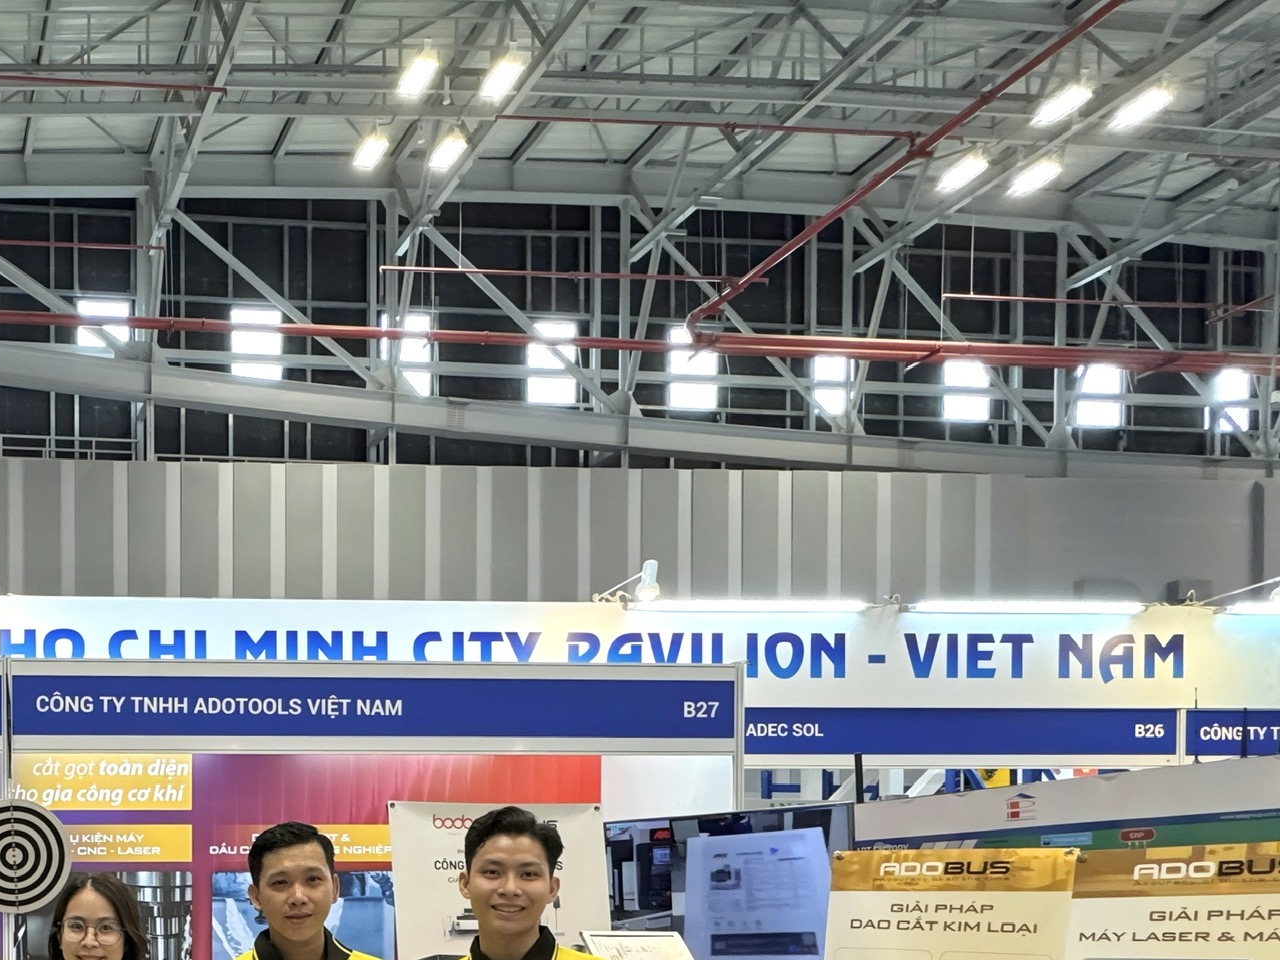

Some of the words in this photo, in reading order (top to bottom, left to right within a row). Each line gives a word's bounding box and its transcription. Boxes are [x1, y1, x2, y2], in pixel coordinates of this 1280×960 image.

[108, 629, 207, 660] CHI
[234, 629, 389, 661] MINH
[412, 631, 542, 663] CITY
[903, 633, 1035, 679] VIET
[1058, 633, 1185, 685] NAM
[35, 691, 94, 713] CÔNG
[99, 696, 127, 713] TY
[130, 696, 189, 714] TNHH
[193, 696, 302, 716] ADOTOOLS
[305, 694, 352, 719] VIỆT
[356, 699, 403, 716] NAM
[683, 701, 719, 718] B27
[745, 723, 789, 737] ADEC
[792, 723, 825, 738] SOL
[1134, 723, 1165, 738] B26
[1199, 722, 1244, 740] CÔNG
[1246, 726, 1268, 740] TY
[32, 758, 61, 776] cắt
[64, 761, 96, 783] gọt
[98, 758, 144, 776] toàn
[147, 758, 189, 779] diện
[41, 785, 71, 806] gia
[76, 784, 123, 806] công
[126, 786, 151, 803] cơ
[153, 784, 185, 803] khí
[81, 833, 113, 845] KIỆN
[115, 832, 145, 843] MÁY
[340, 834, 351, 842] &
[77, 846, 107, 855] CNC
[117, 846, 161, 855] LASER
[342, 843, 392, 857] NGHIỆP
[434, 858, 465, 870] CÔNG
[879, 860, 1011, 876] ADOBUS
[1133, 858, 1280, 880] ADOBU
[890, 901, 929, 914] GIẢI
[934, 901, 994, 914] PHÁP
[1149, 907, 1199, 922] GIẢI
[1206, 906, 1280, 921] PHÁP
[850, 918, 891, 930] DAO
[896, 916, 938, 932] CẮT
[943, 921, 981, 933] KIM
[987, 921, 1038, 936] LOẠI
[1078, 929, 1127, 942] MÁY
[1131, 931, 1210, 942] LASER
[1217, 932, 1236, 942] &
[1243, 928, 1280, 942] MÁ
